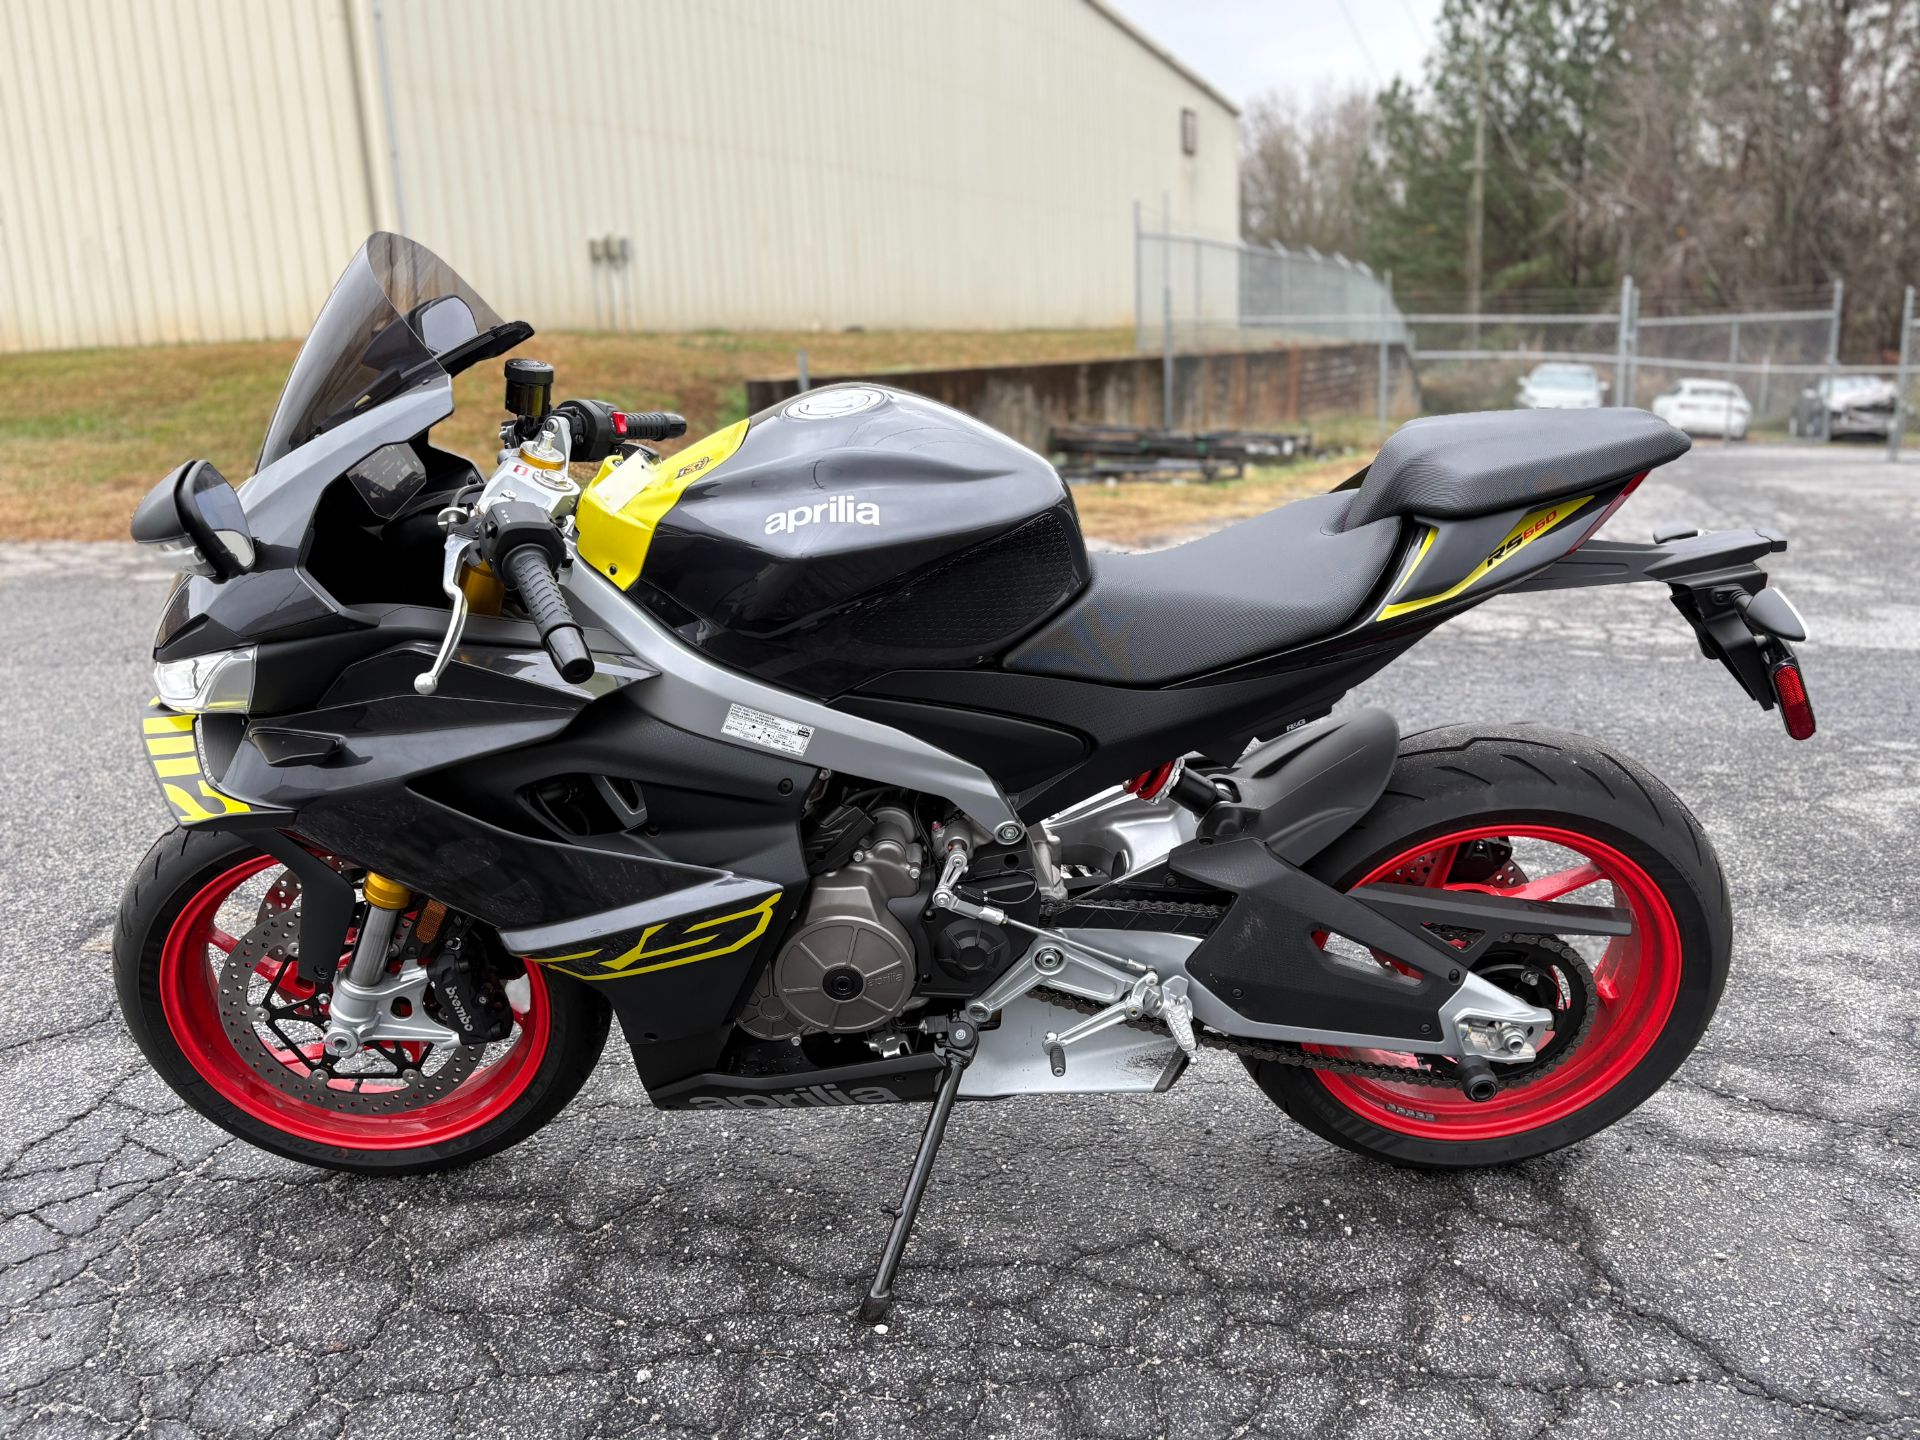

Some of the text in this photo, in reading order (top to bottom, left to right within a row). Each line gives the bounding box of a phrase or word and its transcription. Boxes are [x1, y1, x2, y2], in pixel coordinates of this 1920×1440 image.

[764, 495, 880, 535] aprilia
[445, 985, 473, 1031] brembo
[689, 1083, 901, 1109] aprilia
